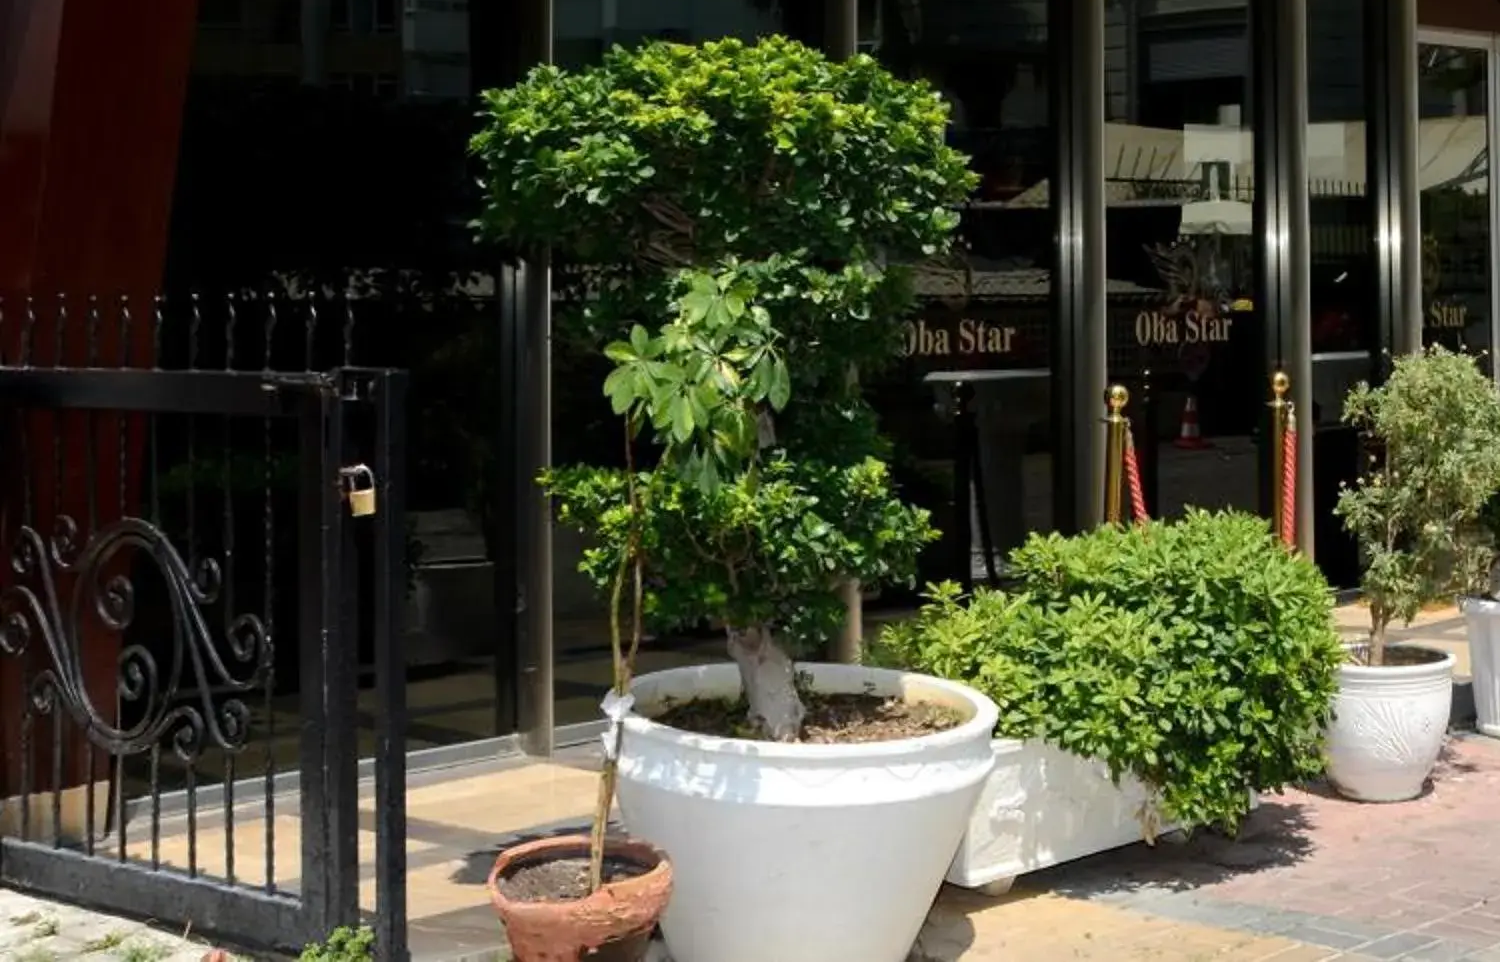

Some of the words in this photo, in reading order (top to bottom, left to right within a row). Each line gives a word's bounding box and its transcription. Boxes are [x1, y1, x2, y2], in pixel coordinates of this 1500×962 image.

[958, 317, 1017, 354] Star
[1135, 310, 1179, 347] Oba
[1185, 308, 1233, 344] Star
